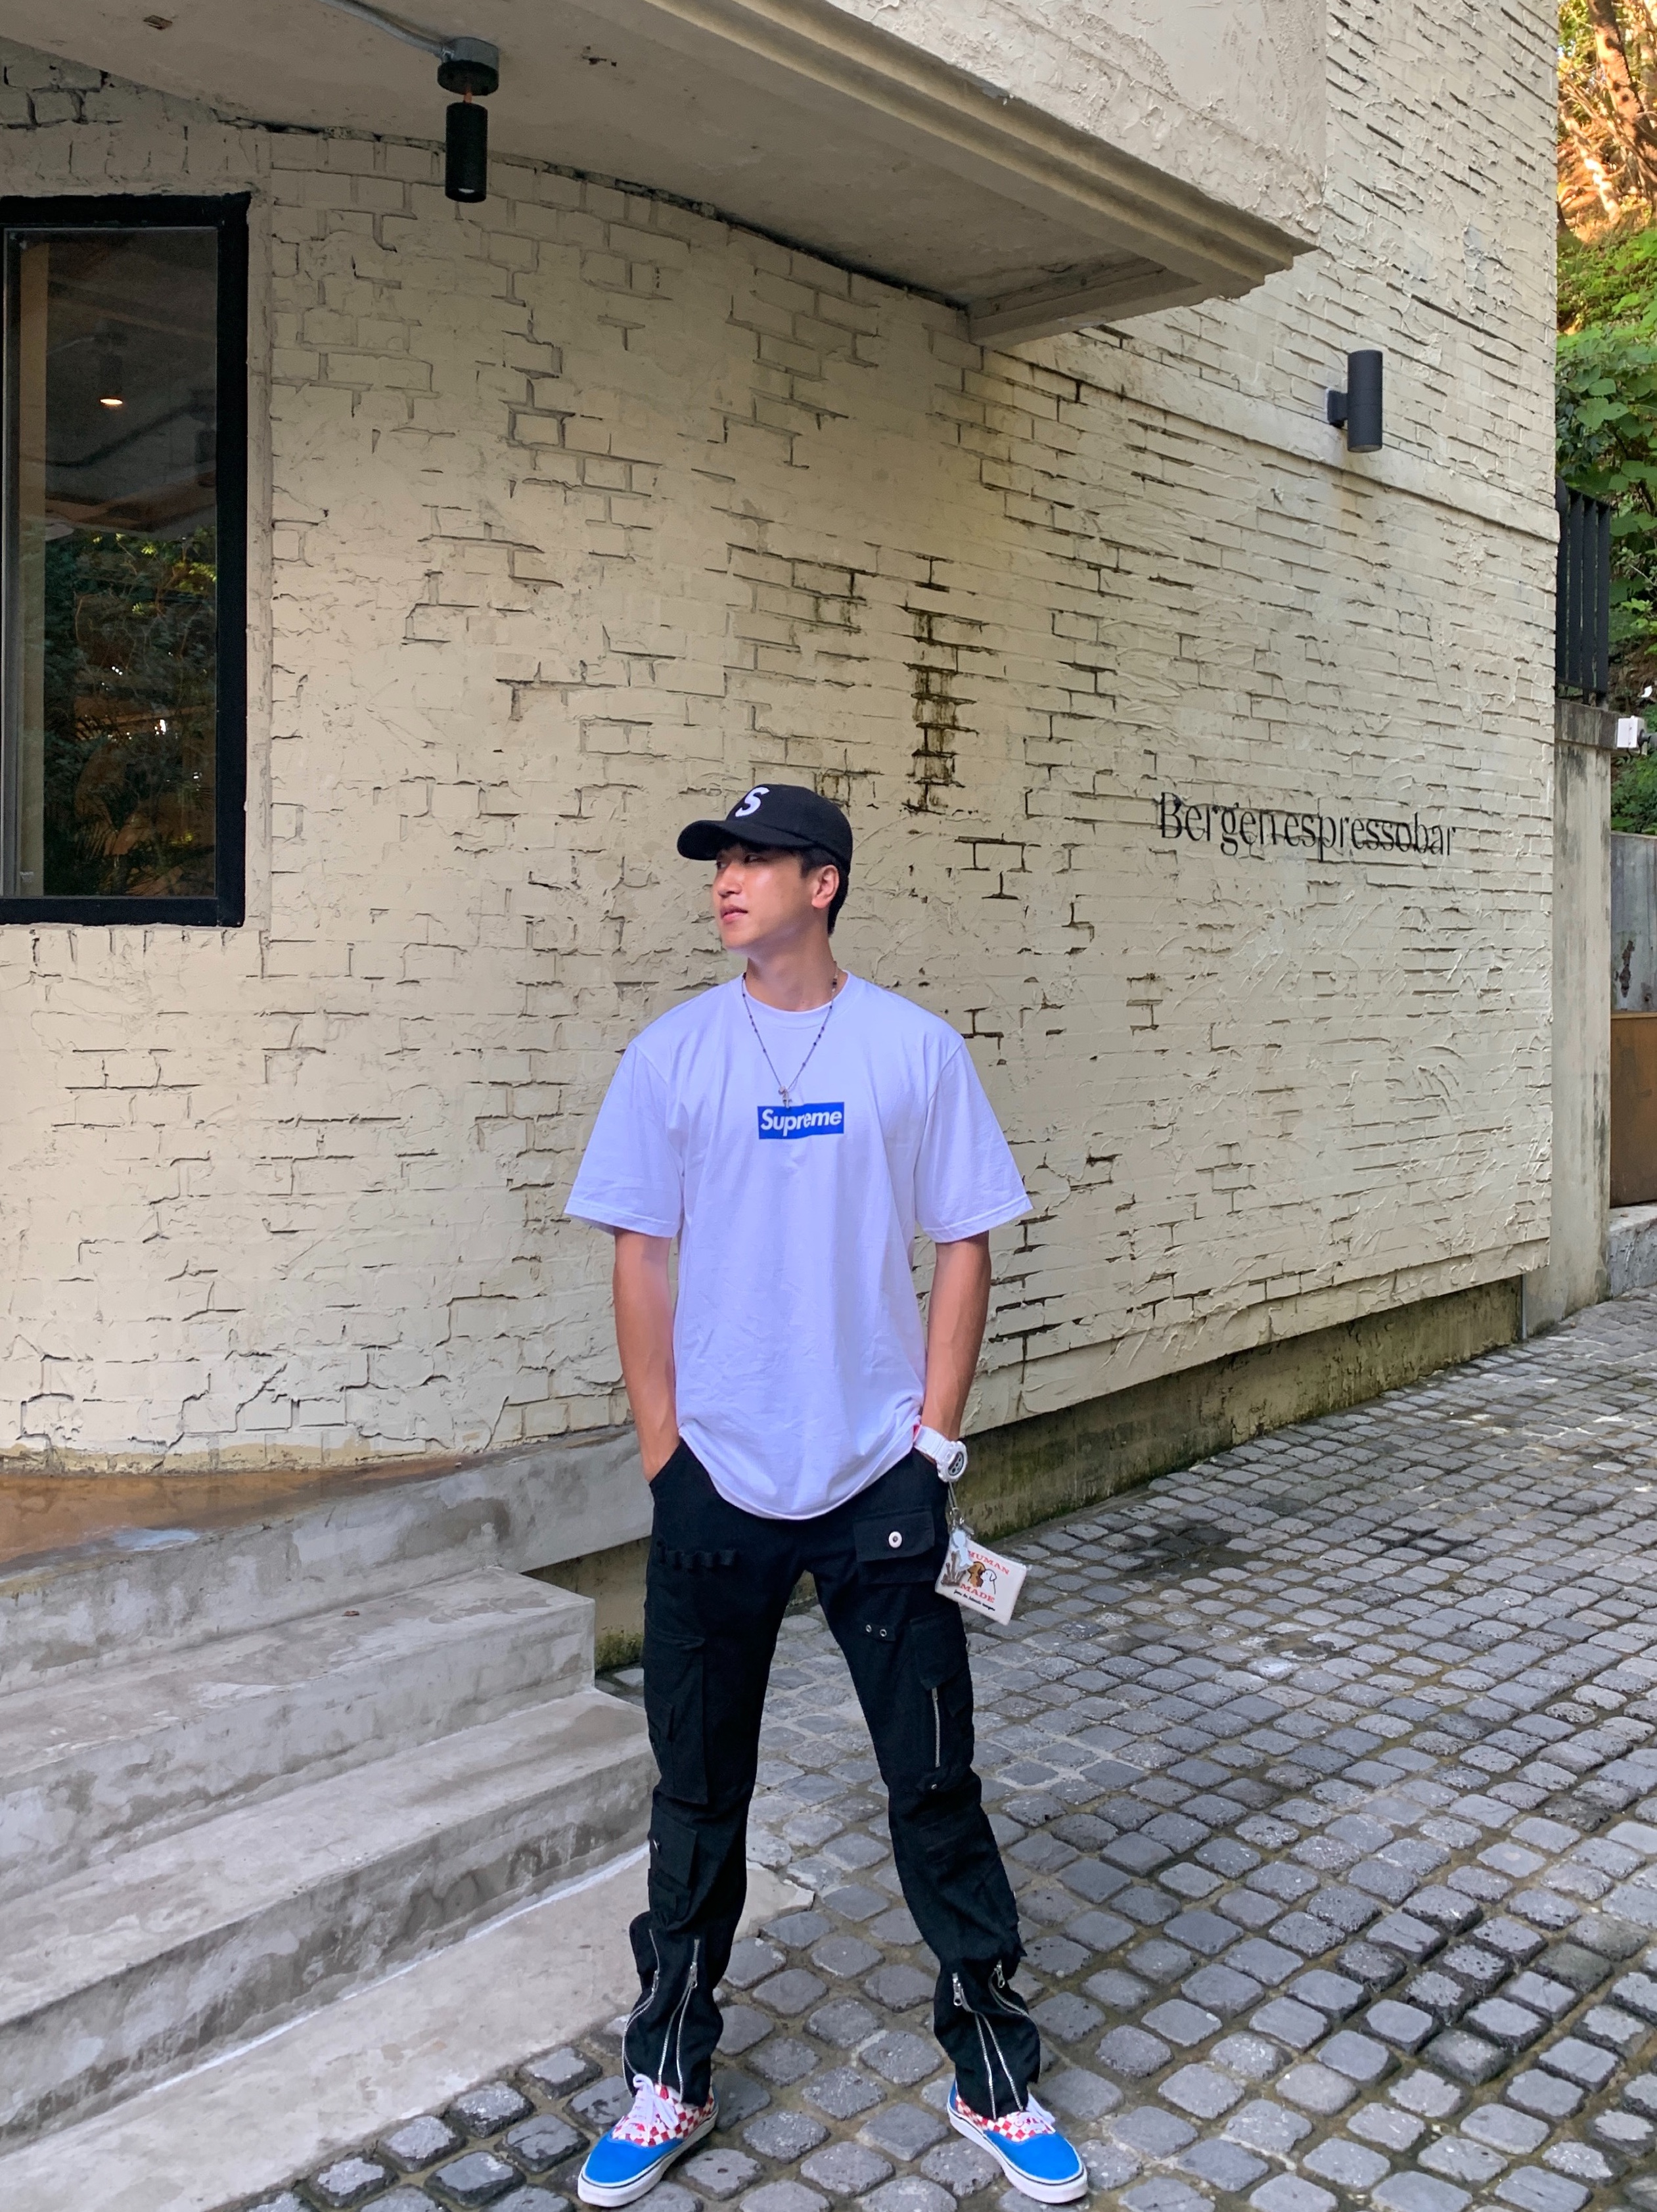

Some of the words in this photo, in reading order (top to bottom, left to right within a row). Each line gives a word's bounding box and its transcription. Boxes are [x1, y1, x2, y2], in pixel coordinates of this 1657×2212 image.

[735, 787, 769, 817] S
[760, 1109, 842, 1137] Supreme
[968, 1550, 1010, 1575] HUMAN
[961, 1583, 995, 1603] MADE
